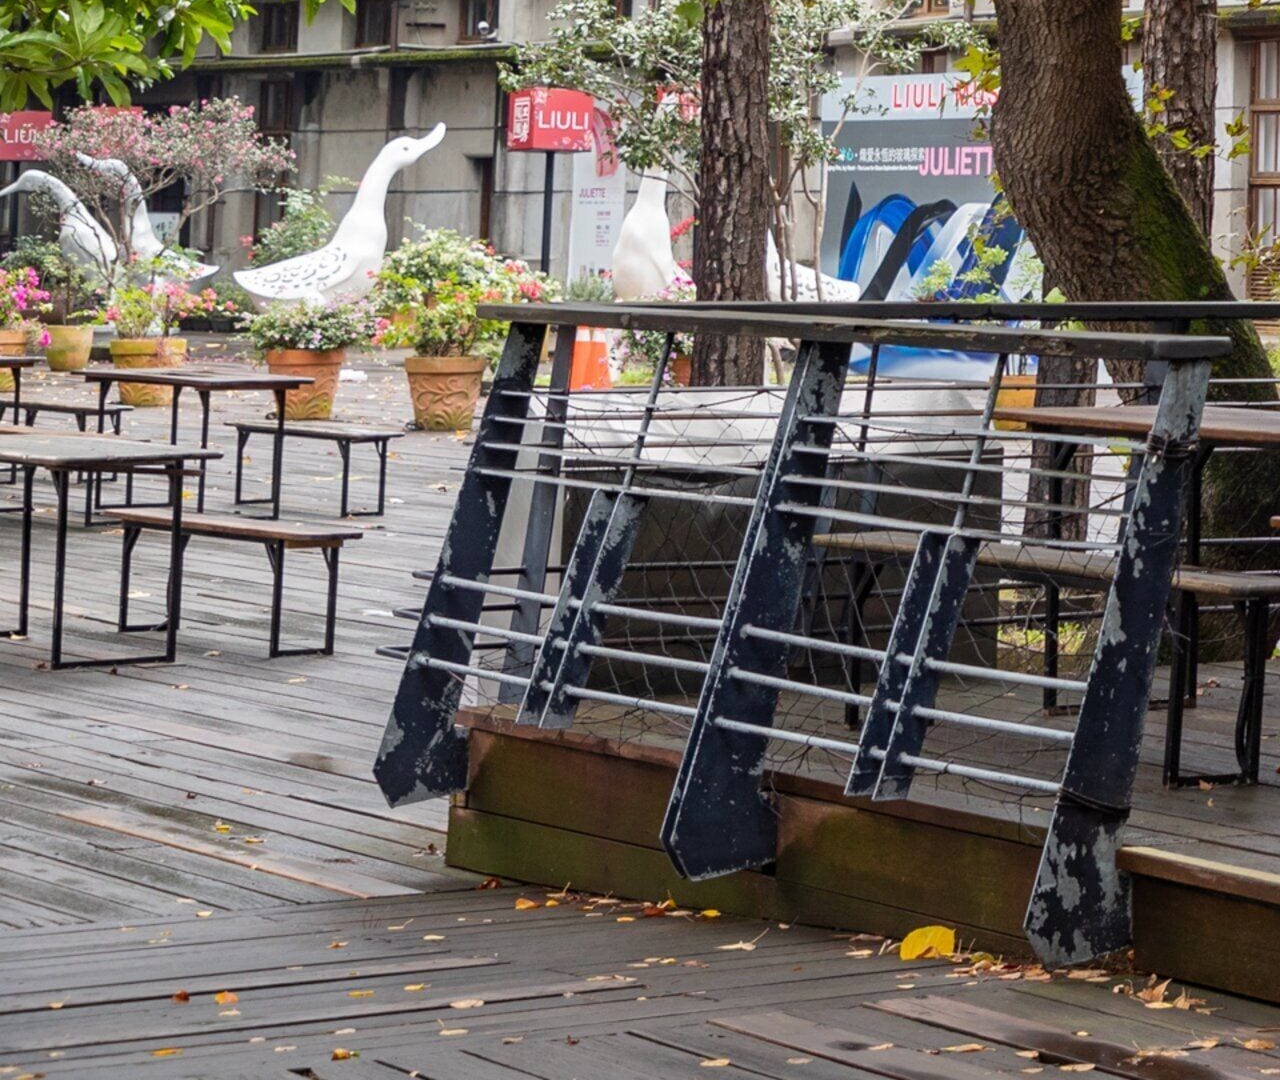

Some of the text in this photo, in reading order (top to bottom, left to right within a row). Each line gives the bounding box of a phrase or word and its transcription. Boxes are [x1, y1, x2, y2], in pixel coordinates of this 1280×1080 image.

[893, 82, 999, 108] LIULI MUS
[538, 110, 589, 130] LIULI
[4, 128, 42, 144] LIU
[919, 146, 993, 176] JULIETT
